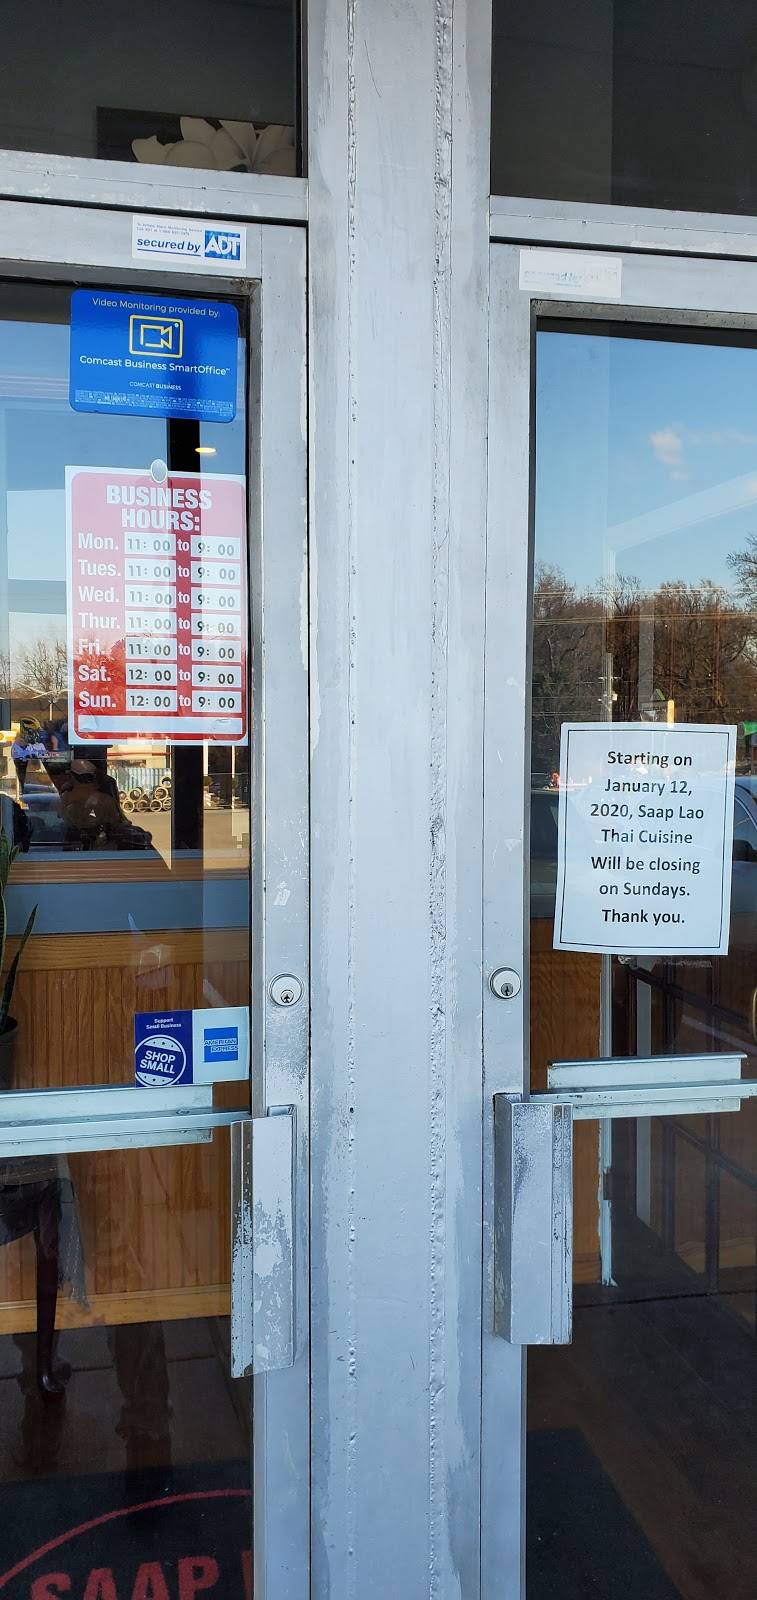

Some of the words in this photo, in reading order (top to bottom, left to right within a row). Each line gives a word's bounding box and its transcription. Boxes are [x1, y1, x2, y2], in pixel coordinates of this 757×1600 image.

[137, 238, 185, 250] secured
[187, 242, 201, 253] by
[205, 235, 240, 256] ADT
[93, 298, 117, 307] Video
[120, 301, 166, 313] Monitoring
[169, 304, 205, 316] provided
[80, 356, 122, 367] Comcast
[125, 359, 166, 370] Business
[107, 485, 212, 510] BUSINESS
[122, 508, 200, 531] HOURS:
[78, 532, 118, 550] Mon.
[177, 539, 189, 551] to
[78, 559, 120, 577] Tues.
[178, 565, 189, 578] to
[78, 586, 119, 602] Wed.
[178, 591, 190, 604] to
[78, 612, 120, 629] Thur.
[178, 617, 190, 630] to
[178, 643, 190, 656] to
[78, 665, 111, 682] Sat.
[178, 668, 191, 681] to
[78, 691, 116, 708] Sun.
[179, 694, 191, 707] to
[607, 751, 668, 768] Starting
[674, 754, 692, 766] on
[605, 779, 664, 795] January
[670, 780, 692, 795] 12,
[590, 804, 632, 819] 2020,
[638, 805, 674, 821] Saap
[679, 806, 704, 819] Lao
[602, 829, 633, 842] Thai
[638, 830, 692, 844] Cuisine
[591, 857, 620, 870] Will
[626, 857, 644, 870] be
[649, 858, 700, 874] closing
[599, 884, 618, 895] on
[624, 883, 690, 898] Sundays.
[602, 910, 648, 923] Thank
[653, 912, 685, 926] you.
[144, 1050, 176, 1064] SHOP
[140, 1059, 175, 1074] SMALL
